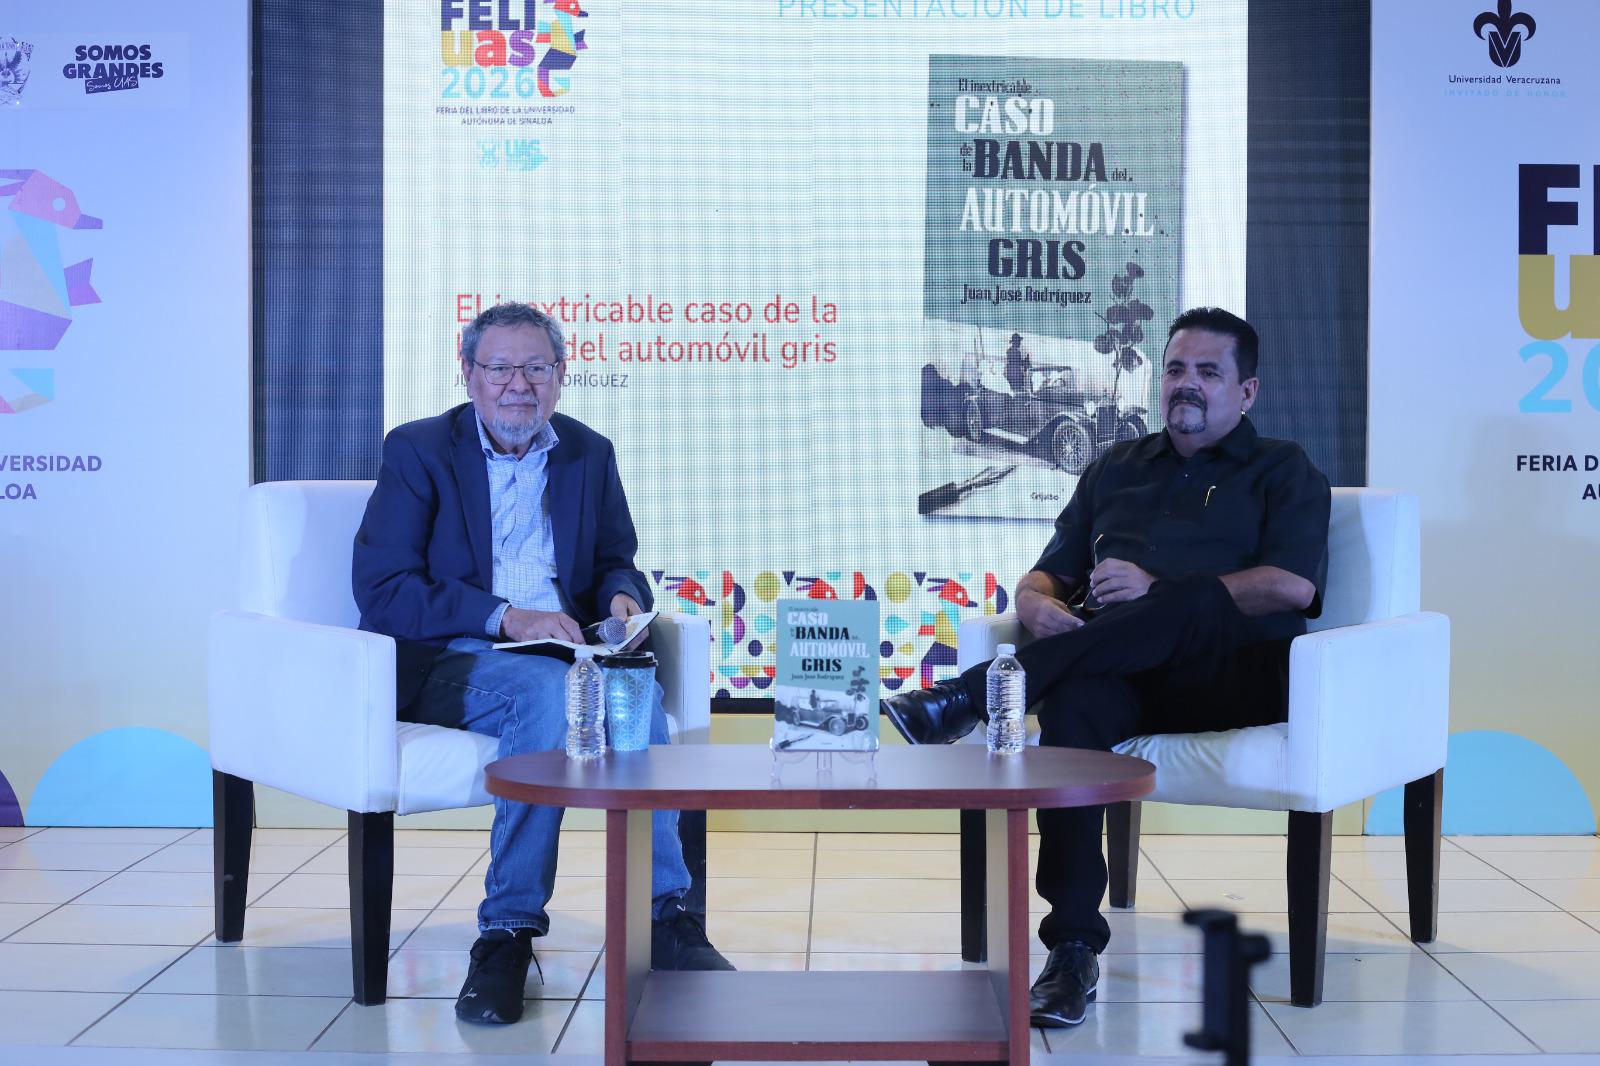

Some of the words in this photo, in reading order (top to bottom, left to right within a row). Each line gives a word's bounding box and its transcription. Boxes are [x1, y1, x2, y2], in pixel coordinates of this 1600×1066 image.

[1045, 0, 1084, 18] DE
[1101, 0, 1195, 18] LIBRO
[75, 45, 152, 61] SOMOS
[62, 62, 164, 79] GRANDES
[86, 81, 112, 92] Somos
[113, 76, 138, 89] UAS
[441, 66, 536, 99] 2026
[959, 78, 967, 92] El
[970, 78, 1032, 94] inextricable
[1448, 75, 1502, 84] Universidad
[1506, 75, 1561, 85] Veracruzana
[436, 105, 458, 114] FERIA
[460, 105, 473, 114] DEL
[476, 105, 497, 114] LIBRO
[500, 106, 510, 114] DE
[512, 106, 522, 114] LA
[954, 95, 1055, 136] CASO
[960, 143, 972, 157] de
[962, 159, 972, 172] la
[973, 138, 1108, 182] BANDA
[959, 183, 1154, 236] AUTOMÓVIL
[988, 238, 1086, 280] GRIS
[961, 283, 992, 305] Juan
[992, 284, 1022, 306] José
[1025, 285, 1092, 307] Rodríguez
[684, 302, 752, 323] caso
[764, 294, 800, 323] de
[812, 294, 837, 323] la
[619, 331, 770, 363] automóvil
[781, 333, 837, 369] gris
[562, 369, 629, 387] DRÍGUEZ
[0, 455, 102, 472] VERSIDAD
[1517, 455, 1578, 471] FERIA
[787, 611, 829, 626] CASO
[795, 626, 850, 640] BANDA
[790, 640, 870, 658] AUTOMÓVIL
[801, 658, 842, 672] GRIS
